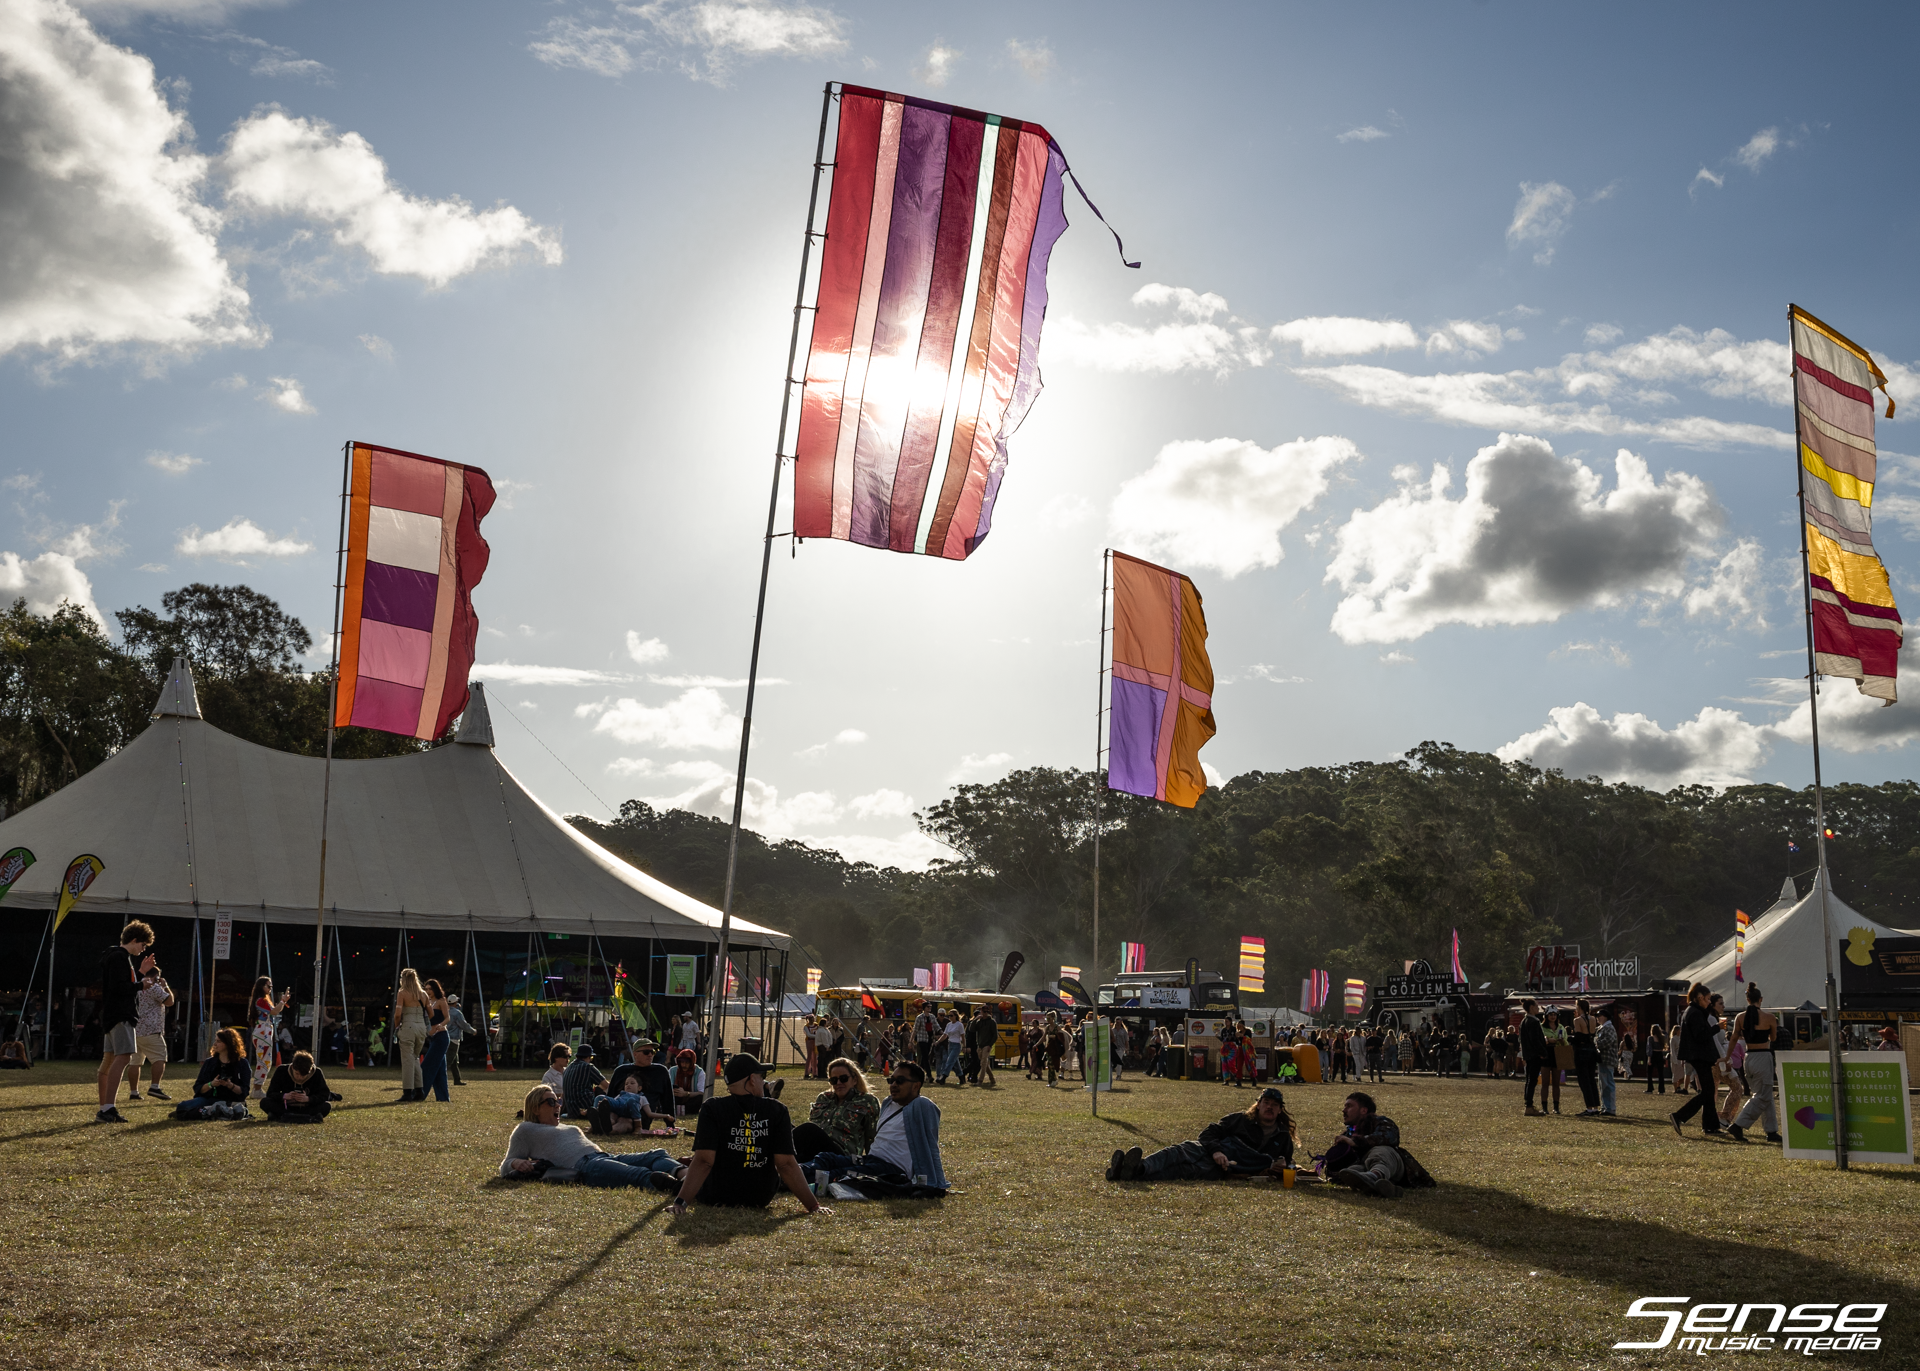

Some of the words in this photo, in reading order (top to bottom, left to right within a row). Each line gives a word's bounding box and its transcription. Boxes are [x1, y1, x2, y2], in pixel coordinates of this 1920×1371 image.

[1526, 946, 1579, 992] Rolling
[1583, 956, 1638, 977] schnitzel
[1390, 982, 1452, 995] GÖZLEME
[1792, 1070, 1832, 1078] FEELIN
[1789, 1095, 1829, 1103] STEADY
[1856, 1096, 1898, 1104] NERVES
[735, 1136, 756, 1145] EXIST
[727, 1142, 762, 1154] TOGETHER
[746, 1153, 757, 1161] IN
